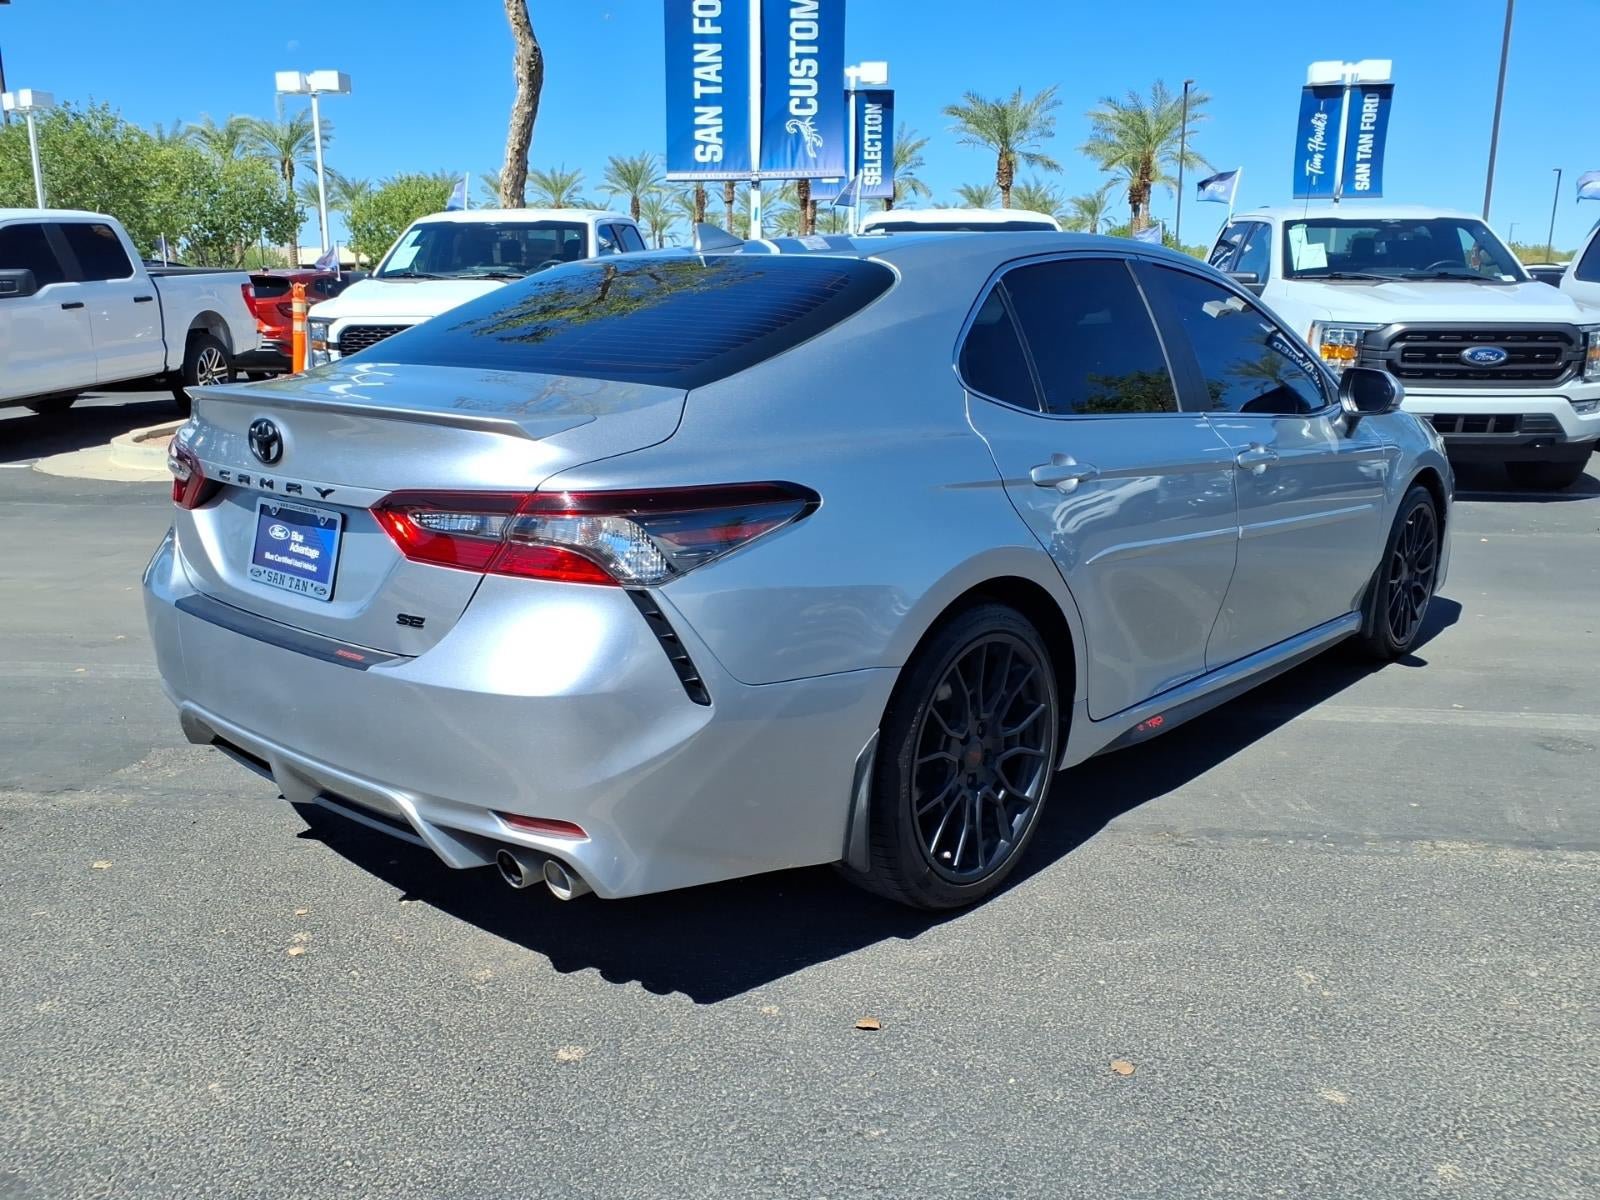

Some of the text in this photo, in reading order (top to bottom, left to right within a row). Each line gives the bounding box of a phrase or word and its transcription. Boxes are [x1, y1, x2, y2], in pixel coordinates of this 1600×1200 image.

[693, 43, 723, 99] TAN
[789, 0, 819, 116] CUSTOM
[694, 106, 723, 163] SAN
[863, 103, 883, 186] SELECTION
[1355, 93, 1380, 191] SAN TAN FORD
[1306, 152, 1325, 177] Tim
[218, 470, 336, 500] CAMRY
[267, 571, 286, 586] SAN
[288, 577, 309, 593] TAN
[396, 613, 426, 628] SE
